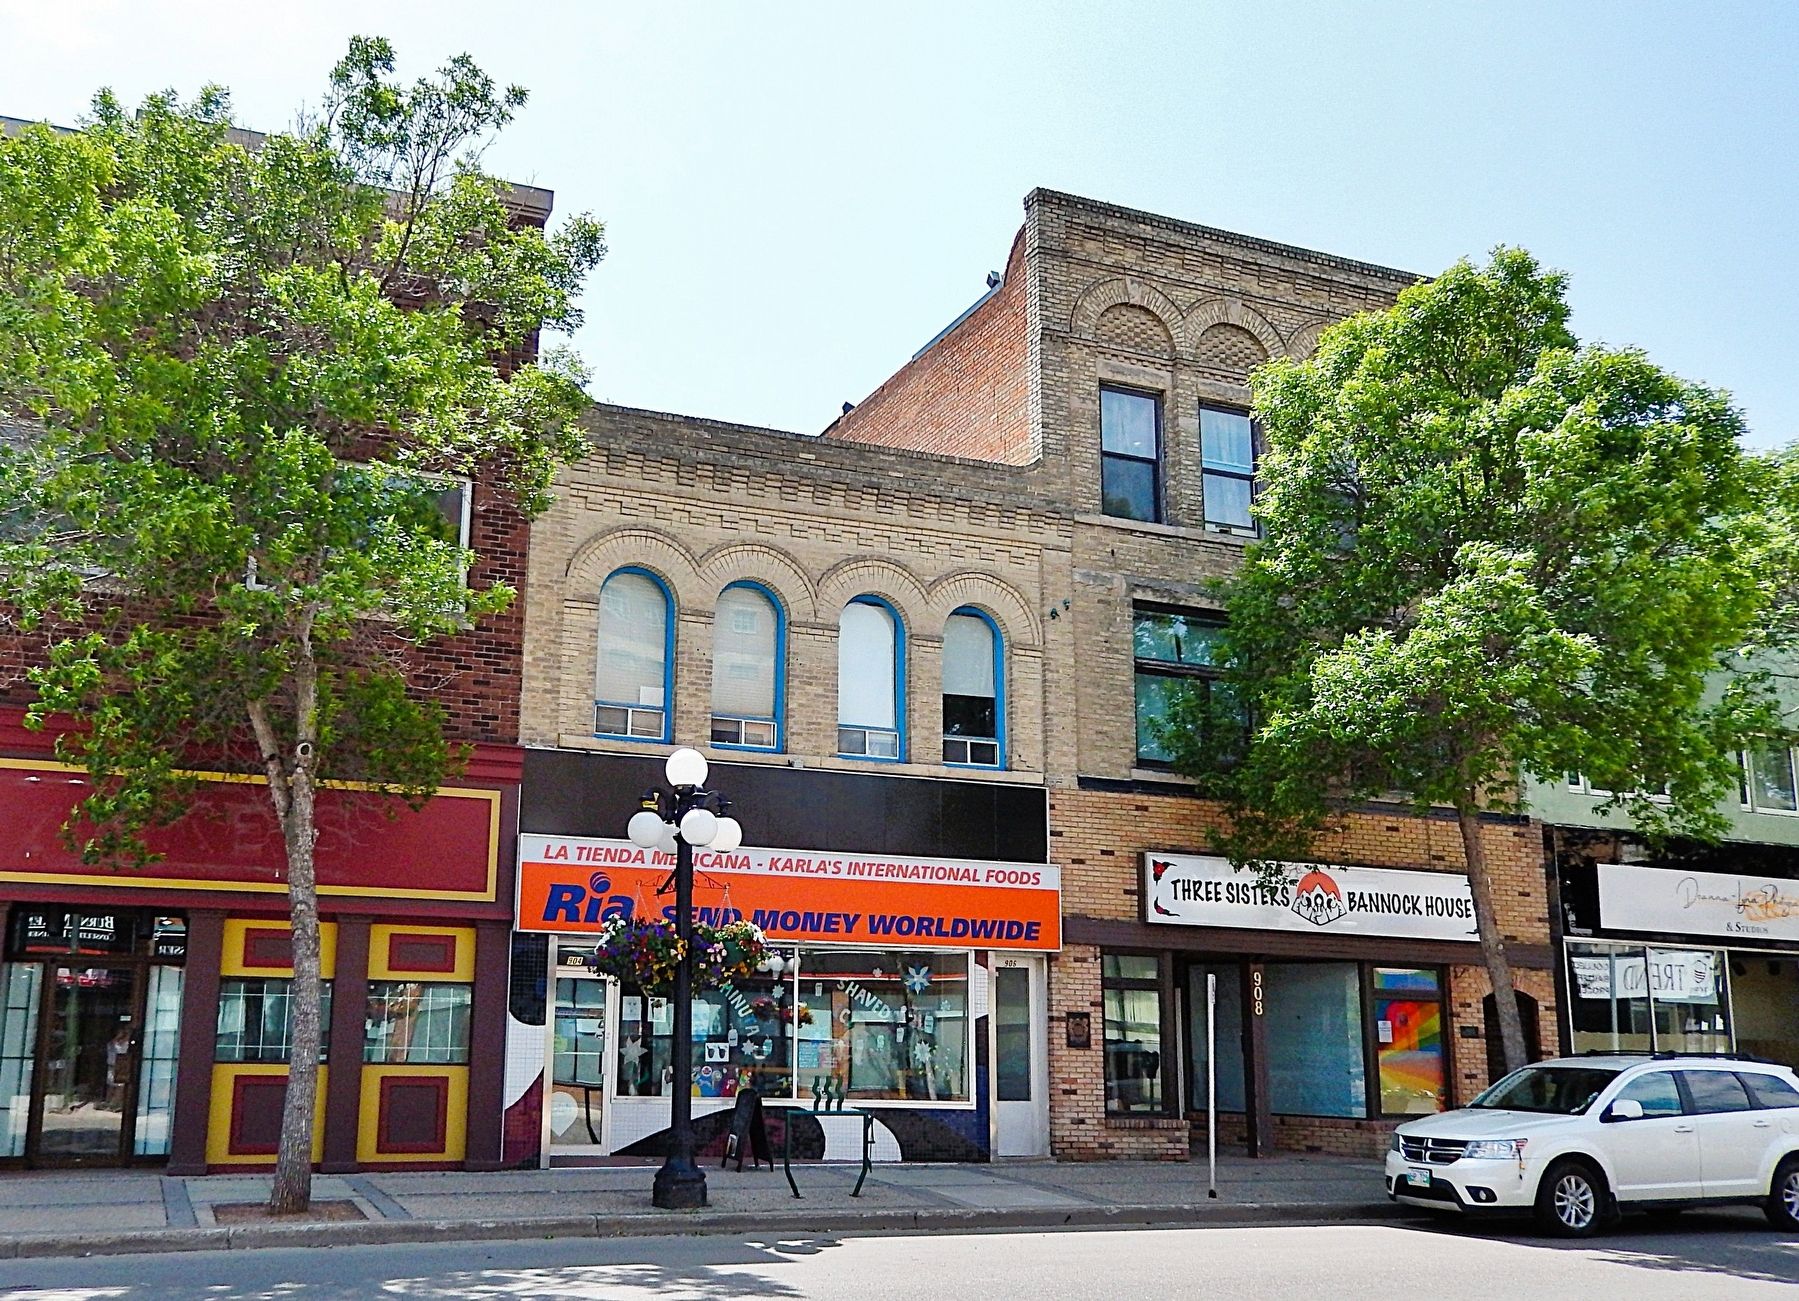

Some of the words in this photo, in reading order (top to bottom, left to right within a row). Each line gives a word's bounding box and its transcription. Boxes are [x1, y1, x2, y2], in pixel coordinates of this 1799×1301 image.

[543, 844, 569, 860] LA
[576, 846, 646, 864] TIENDA
[651, 850, 751, 870] MEICANA
[768, 857, 842, 875] KARLA'S
[847, 862, 981, 882] INTERNATIONAL
[985, 869, 1041, 886] FOODS
[542, 871, 635, 924] Ria
[1170, 878, 1222, 902] THREE
[1225, 882, 1290, 907] SISTERS
[1346, 891, 1423, 916] BANNOCK
[1425, 896, 1472, 918] HOUSE
[750, 909, 861, 933] MONEY
[868, 914, 1042, 941] WORLDWIDE
[836, 980, 891, 1018] SHAVED
[1253, 971, 1264, 1016] 908
